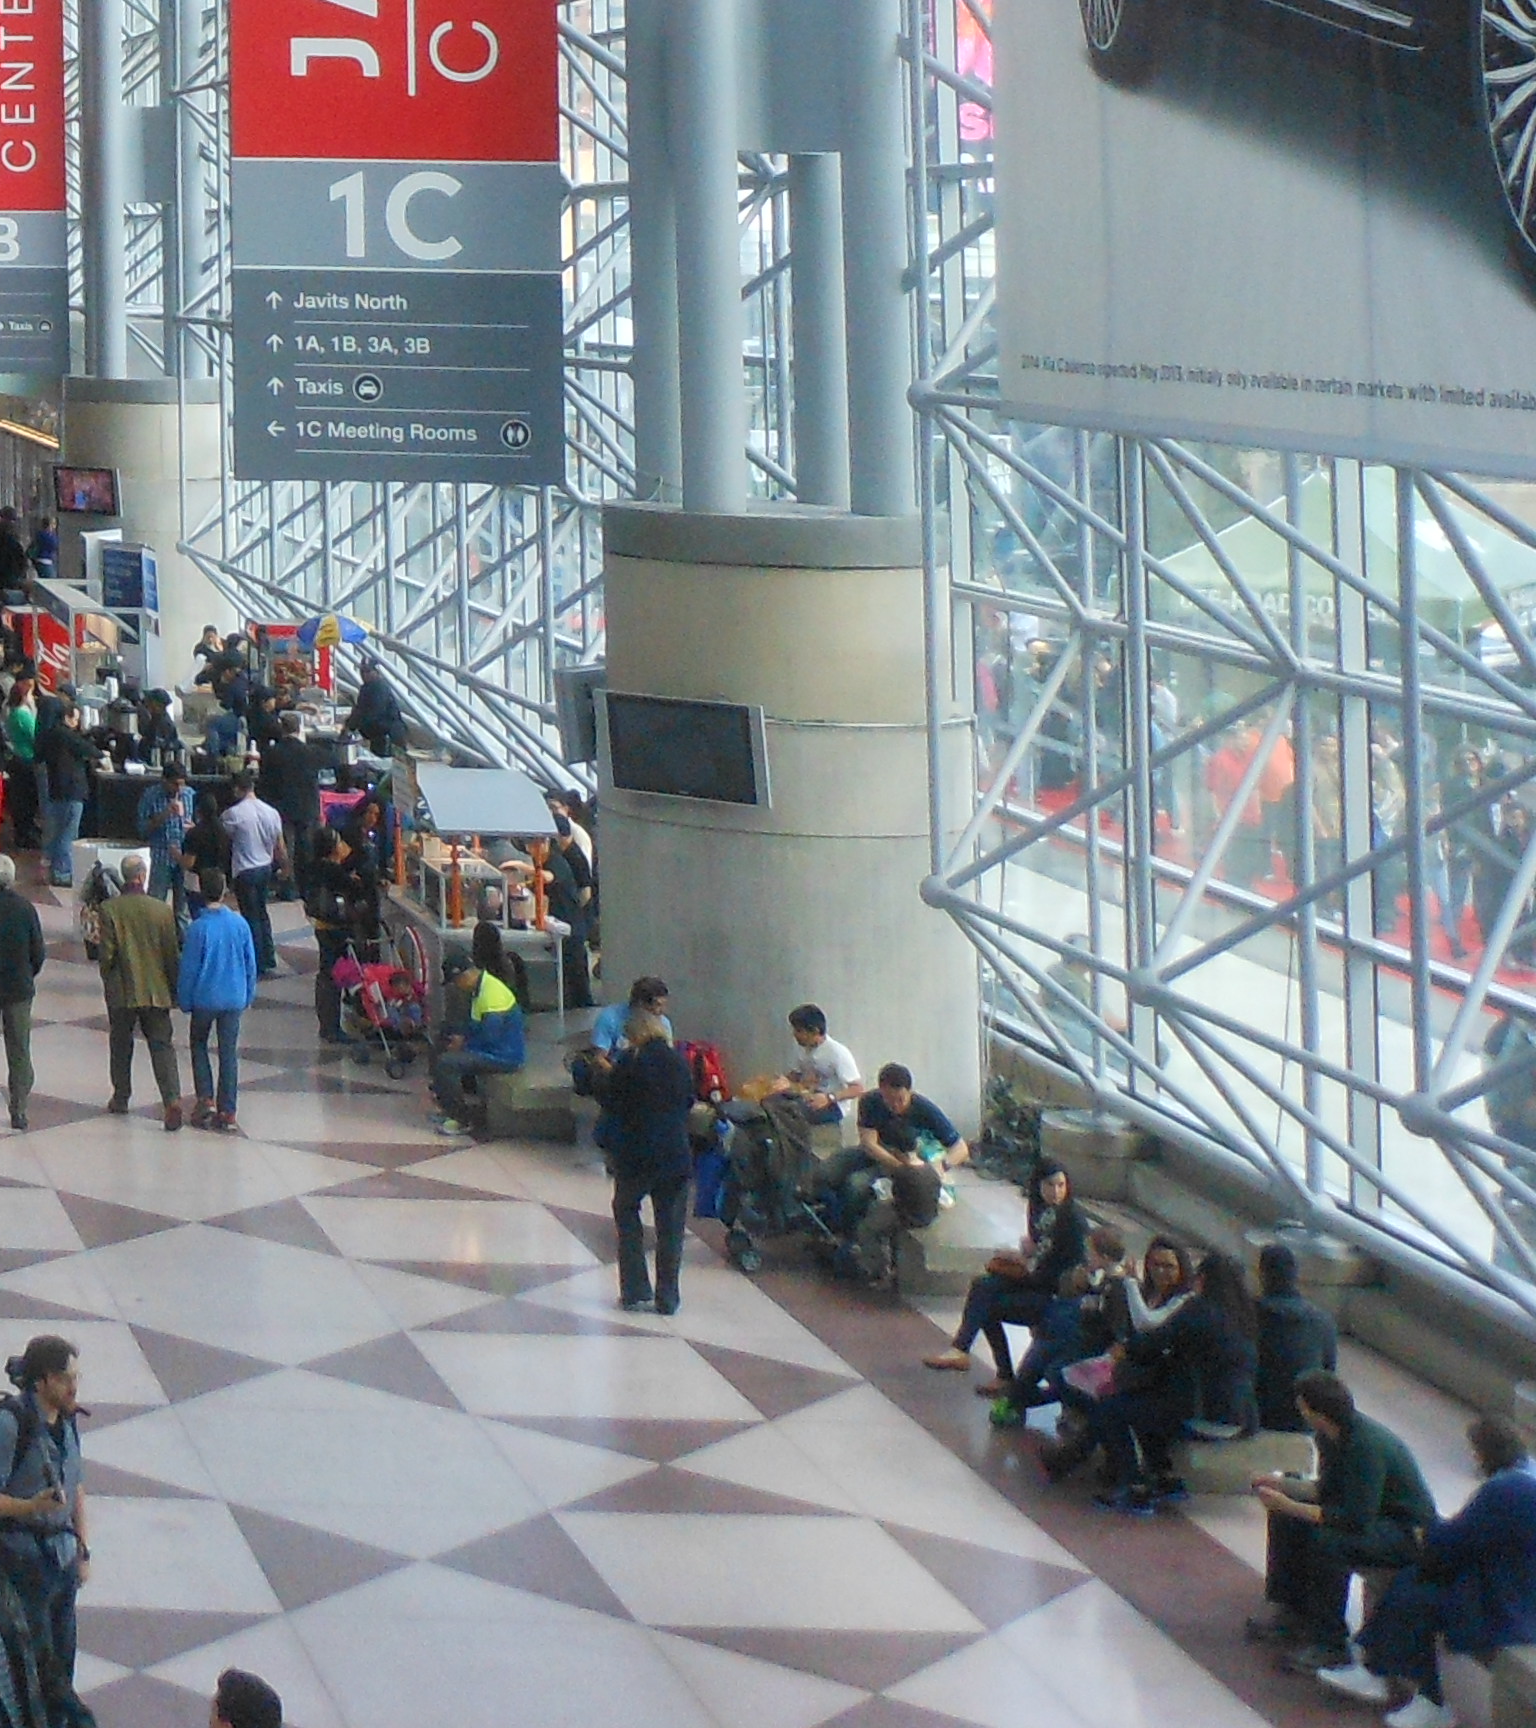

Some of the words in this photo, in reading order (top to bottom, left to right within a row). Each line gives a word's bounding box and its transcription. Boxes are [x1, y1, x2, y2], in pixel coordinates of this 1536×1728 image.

[328, 170, 466, 261] 1C
[293, 292, 349, 310] Javits
[355, 293, 408, 311] North
[294, 335, 325, 354] 1A,
[331, 335, 362, 354] 1B,
[368, 336, 399, 355] 3A,
[404, 336, 431, 354] 3B
[295, 377, 344, 395] Taxis
[1357, 379, 1403, 399] markets
[1406, 382, 1435, 402] with
[1439, 383, 1484, 406] limited
[296, 420, 322, 438] 1C
[328, 421, 405, 443] Meeting
[410, 422, 477, 442] Rooms
